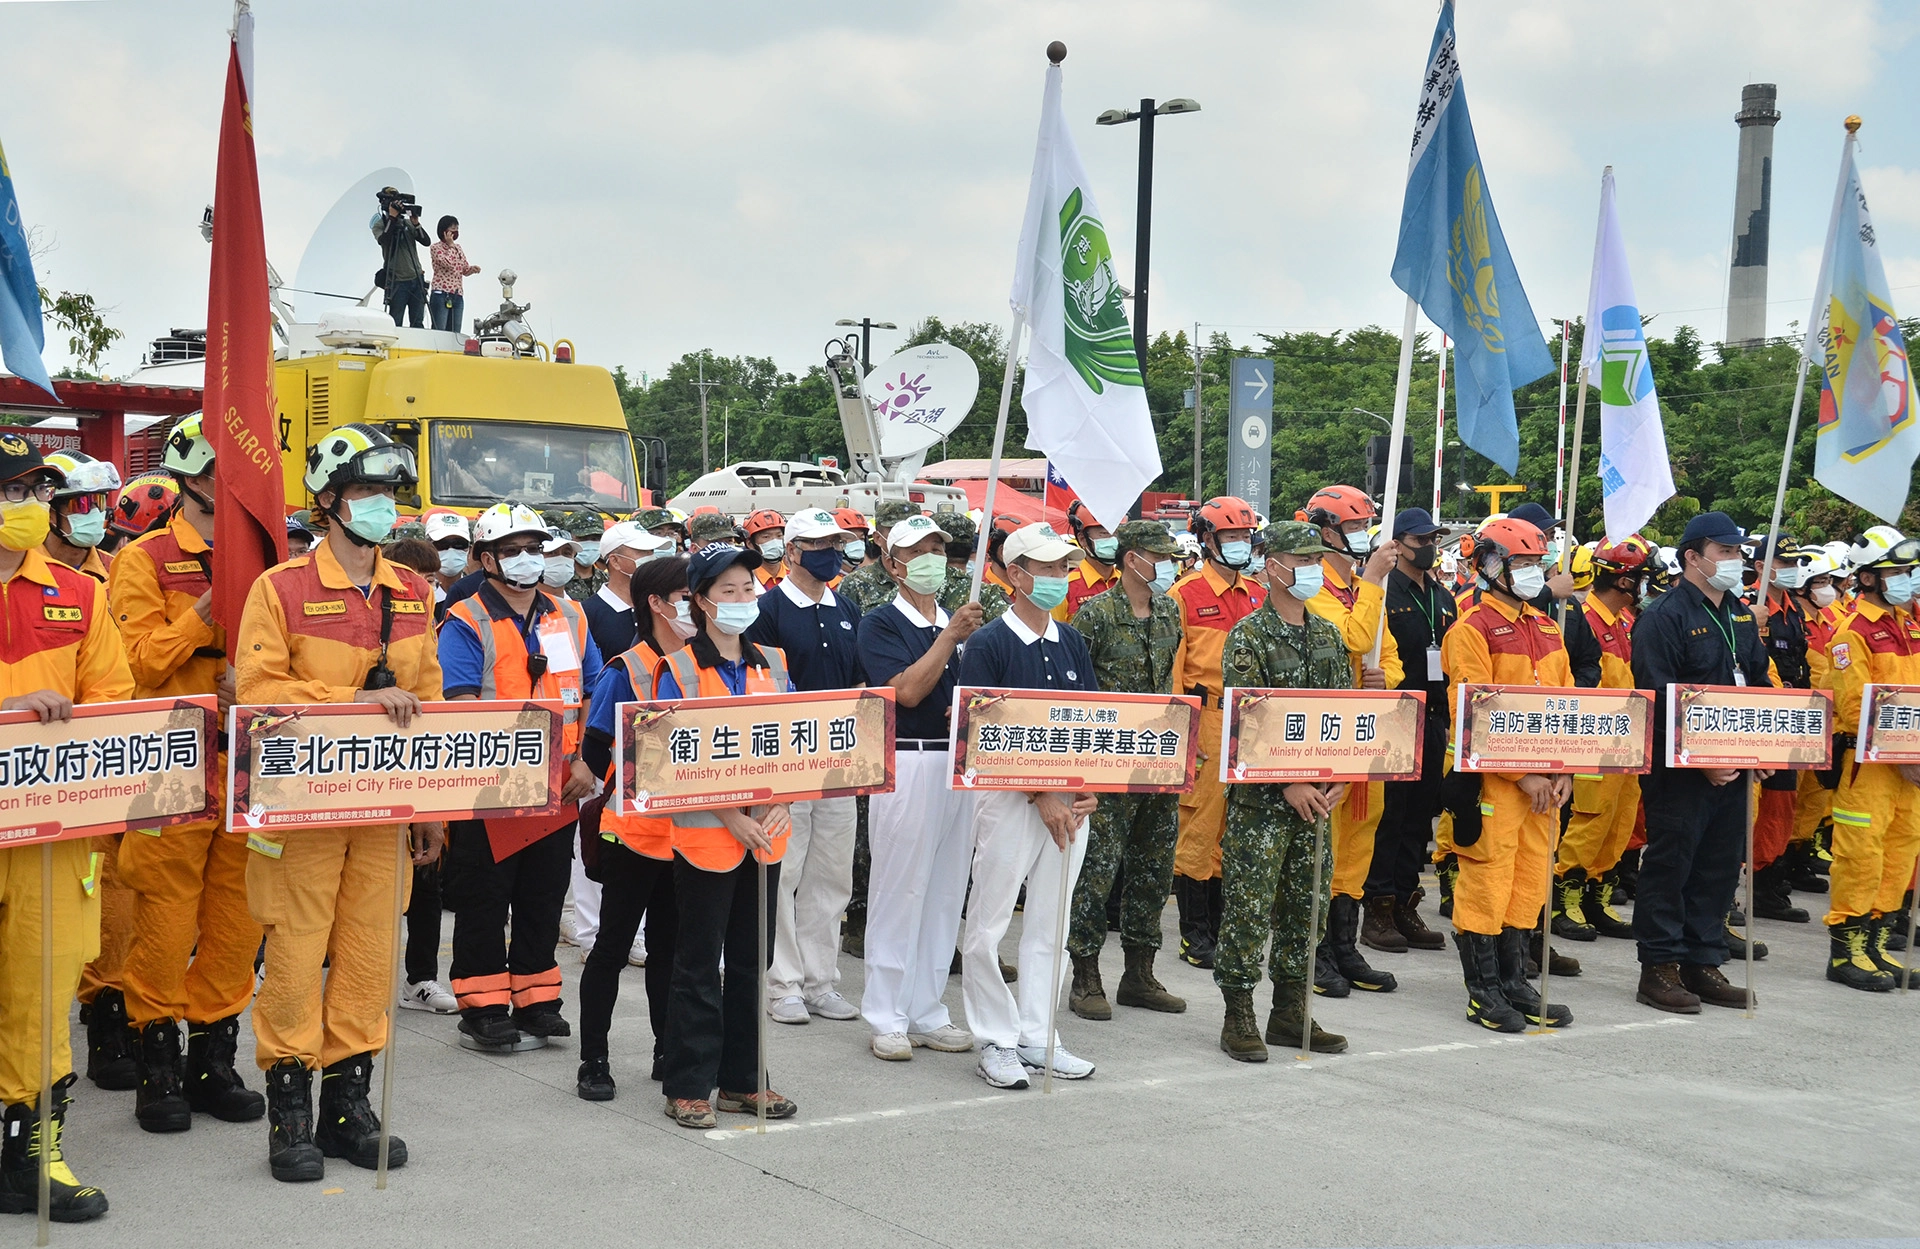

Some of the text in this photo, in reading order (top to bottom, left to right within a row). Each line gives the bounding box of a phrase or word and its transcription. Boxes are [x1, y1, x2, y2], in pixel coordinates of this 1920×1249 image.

[904, 407, 946, 424] 公視
[18, 433, 82, 449] 博物館
[224, 406, 274, 475] SEARCH
[438, 424, 473, 441] FCV01
[1049, 707, 1118, 723] 財團法人佛教
[1489, 711, 1631, 736] 消防署特種搜救隊
[1686, 705, 1823, 735] 行政院環境保護署
[1285, 712, 1377, 743] 國防部
[1882, 732, 1919, 743] Tainan City
[669, 717, 857, 763] 衛生福利部
[979, 724, 1180, 757] 慈濟慈善事業基金會
[1269, 745, 1388, 759] Ministry of National Defense
[1487, 744, 1630, 756] National Fire Agency, Ministry of the Interior
[1488, 736, 1513, 746] Special
[1514, 736, 1538, 745] Search
[1539, 736, 1553, 745] and
[1555, 737, 1578, 746] Rescue
[1686, 736, 1823, 749] Environmental Protection Administration
[0, 729, 198, 787] 政府消防局
[260, 730, 543, 776] 臺北市政府消防局
[975, 756, 1179, 770] Buddhist Compassion Relief Tzu Chi Foundation
[675, 756, 852, 781] Ministry of Health and Welfare
[25, 792, 52, 807] Fire
[57, 780, 147, 804] Department
[307, 773, 500, 797] Taipei City Fire Department
